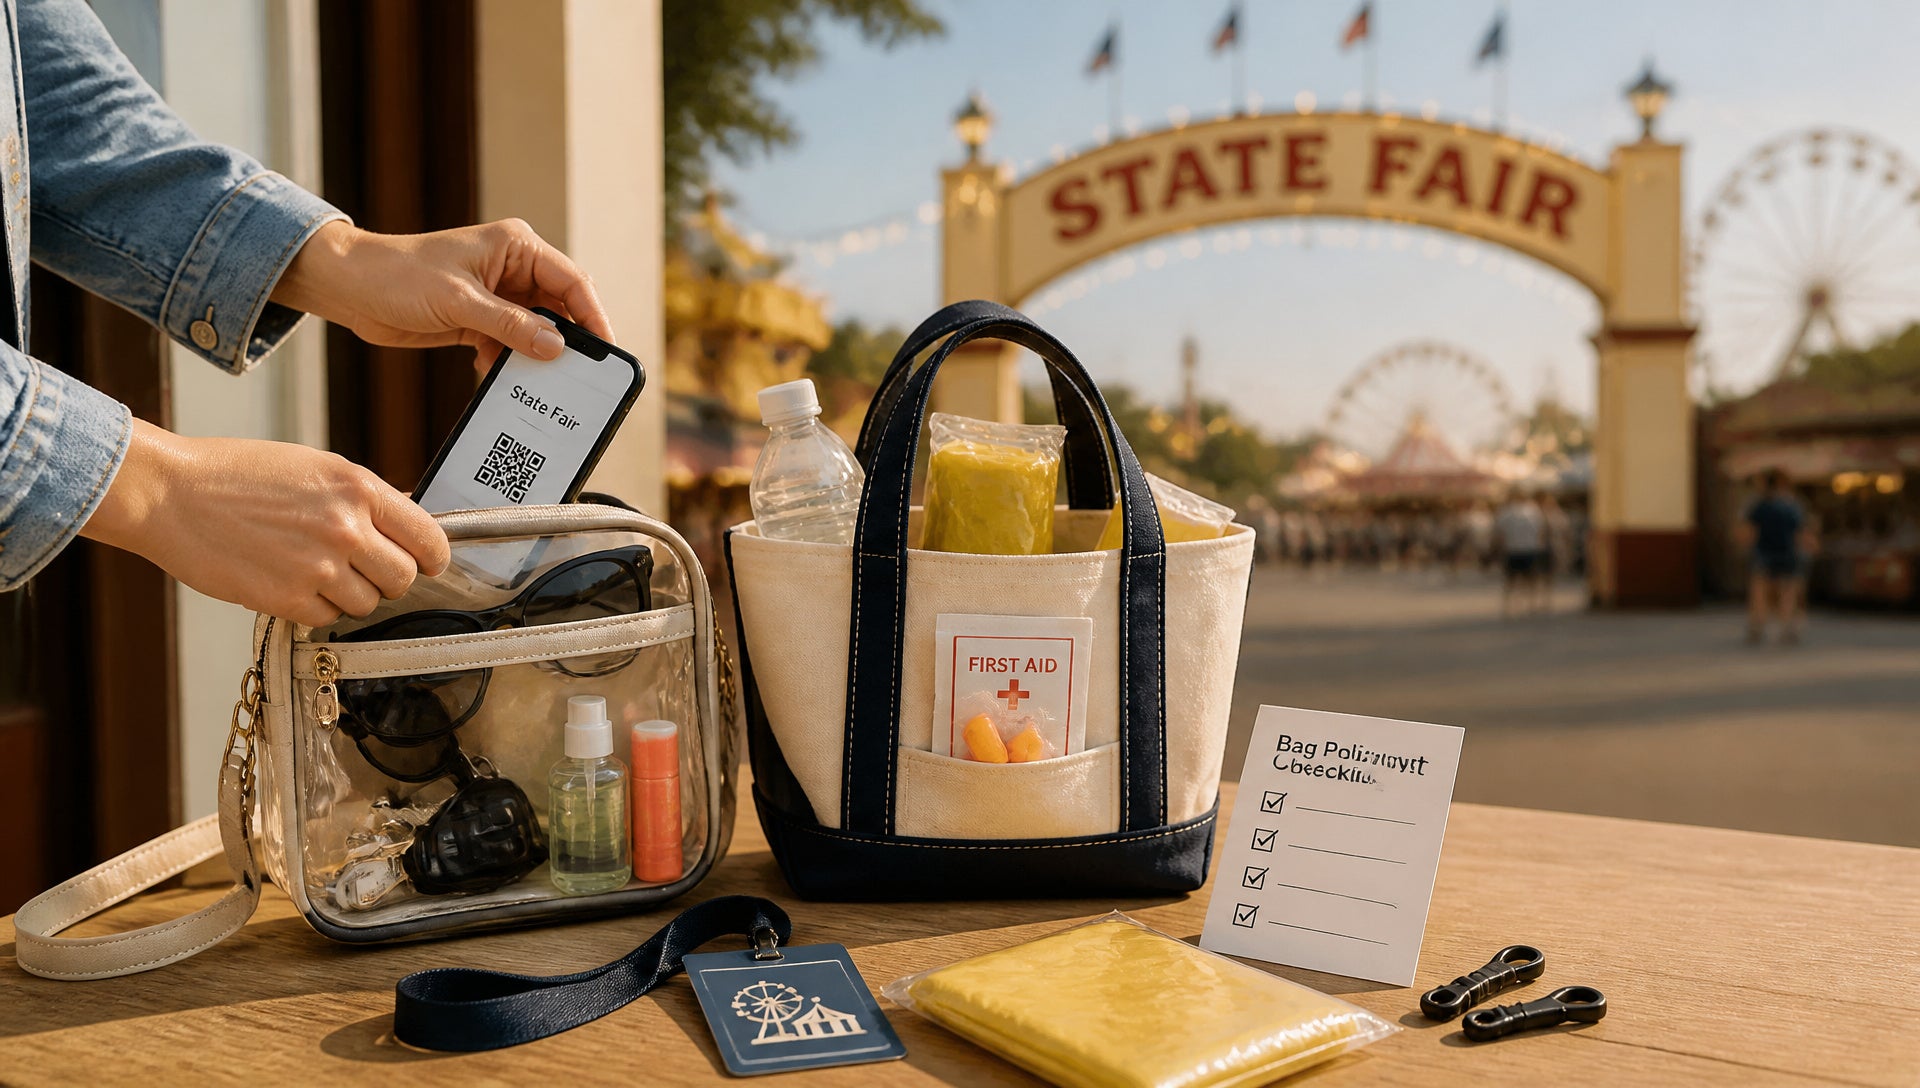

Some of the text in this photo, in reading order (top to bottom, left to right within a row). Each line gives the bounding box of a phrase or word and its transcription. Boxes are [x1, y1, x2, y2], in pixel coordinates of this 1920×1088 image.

[1047, 132, 1581, 242] STATE FAIR
[510, 385, 580, 430] State Fair
[968, 656, 1058, 673] FIRST AID
[1276, 734, 1318, 760] Bag
